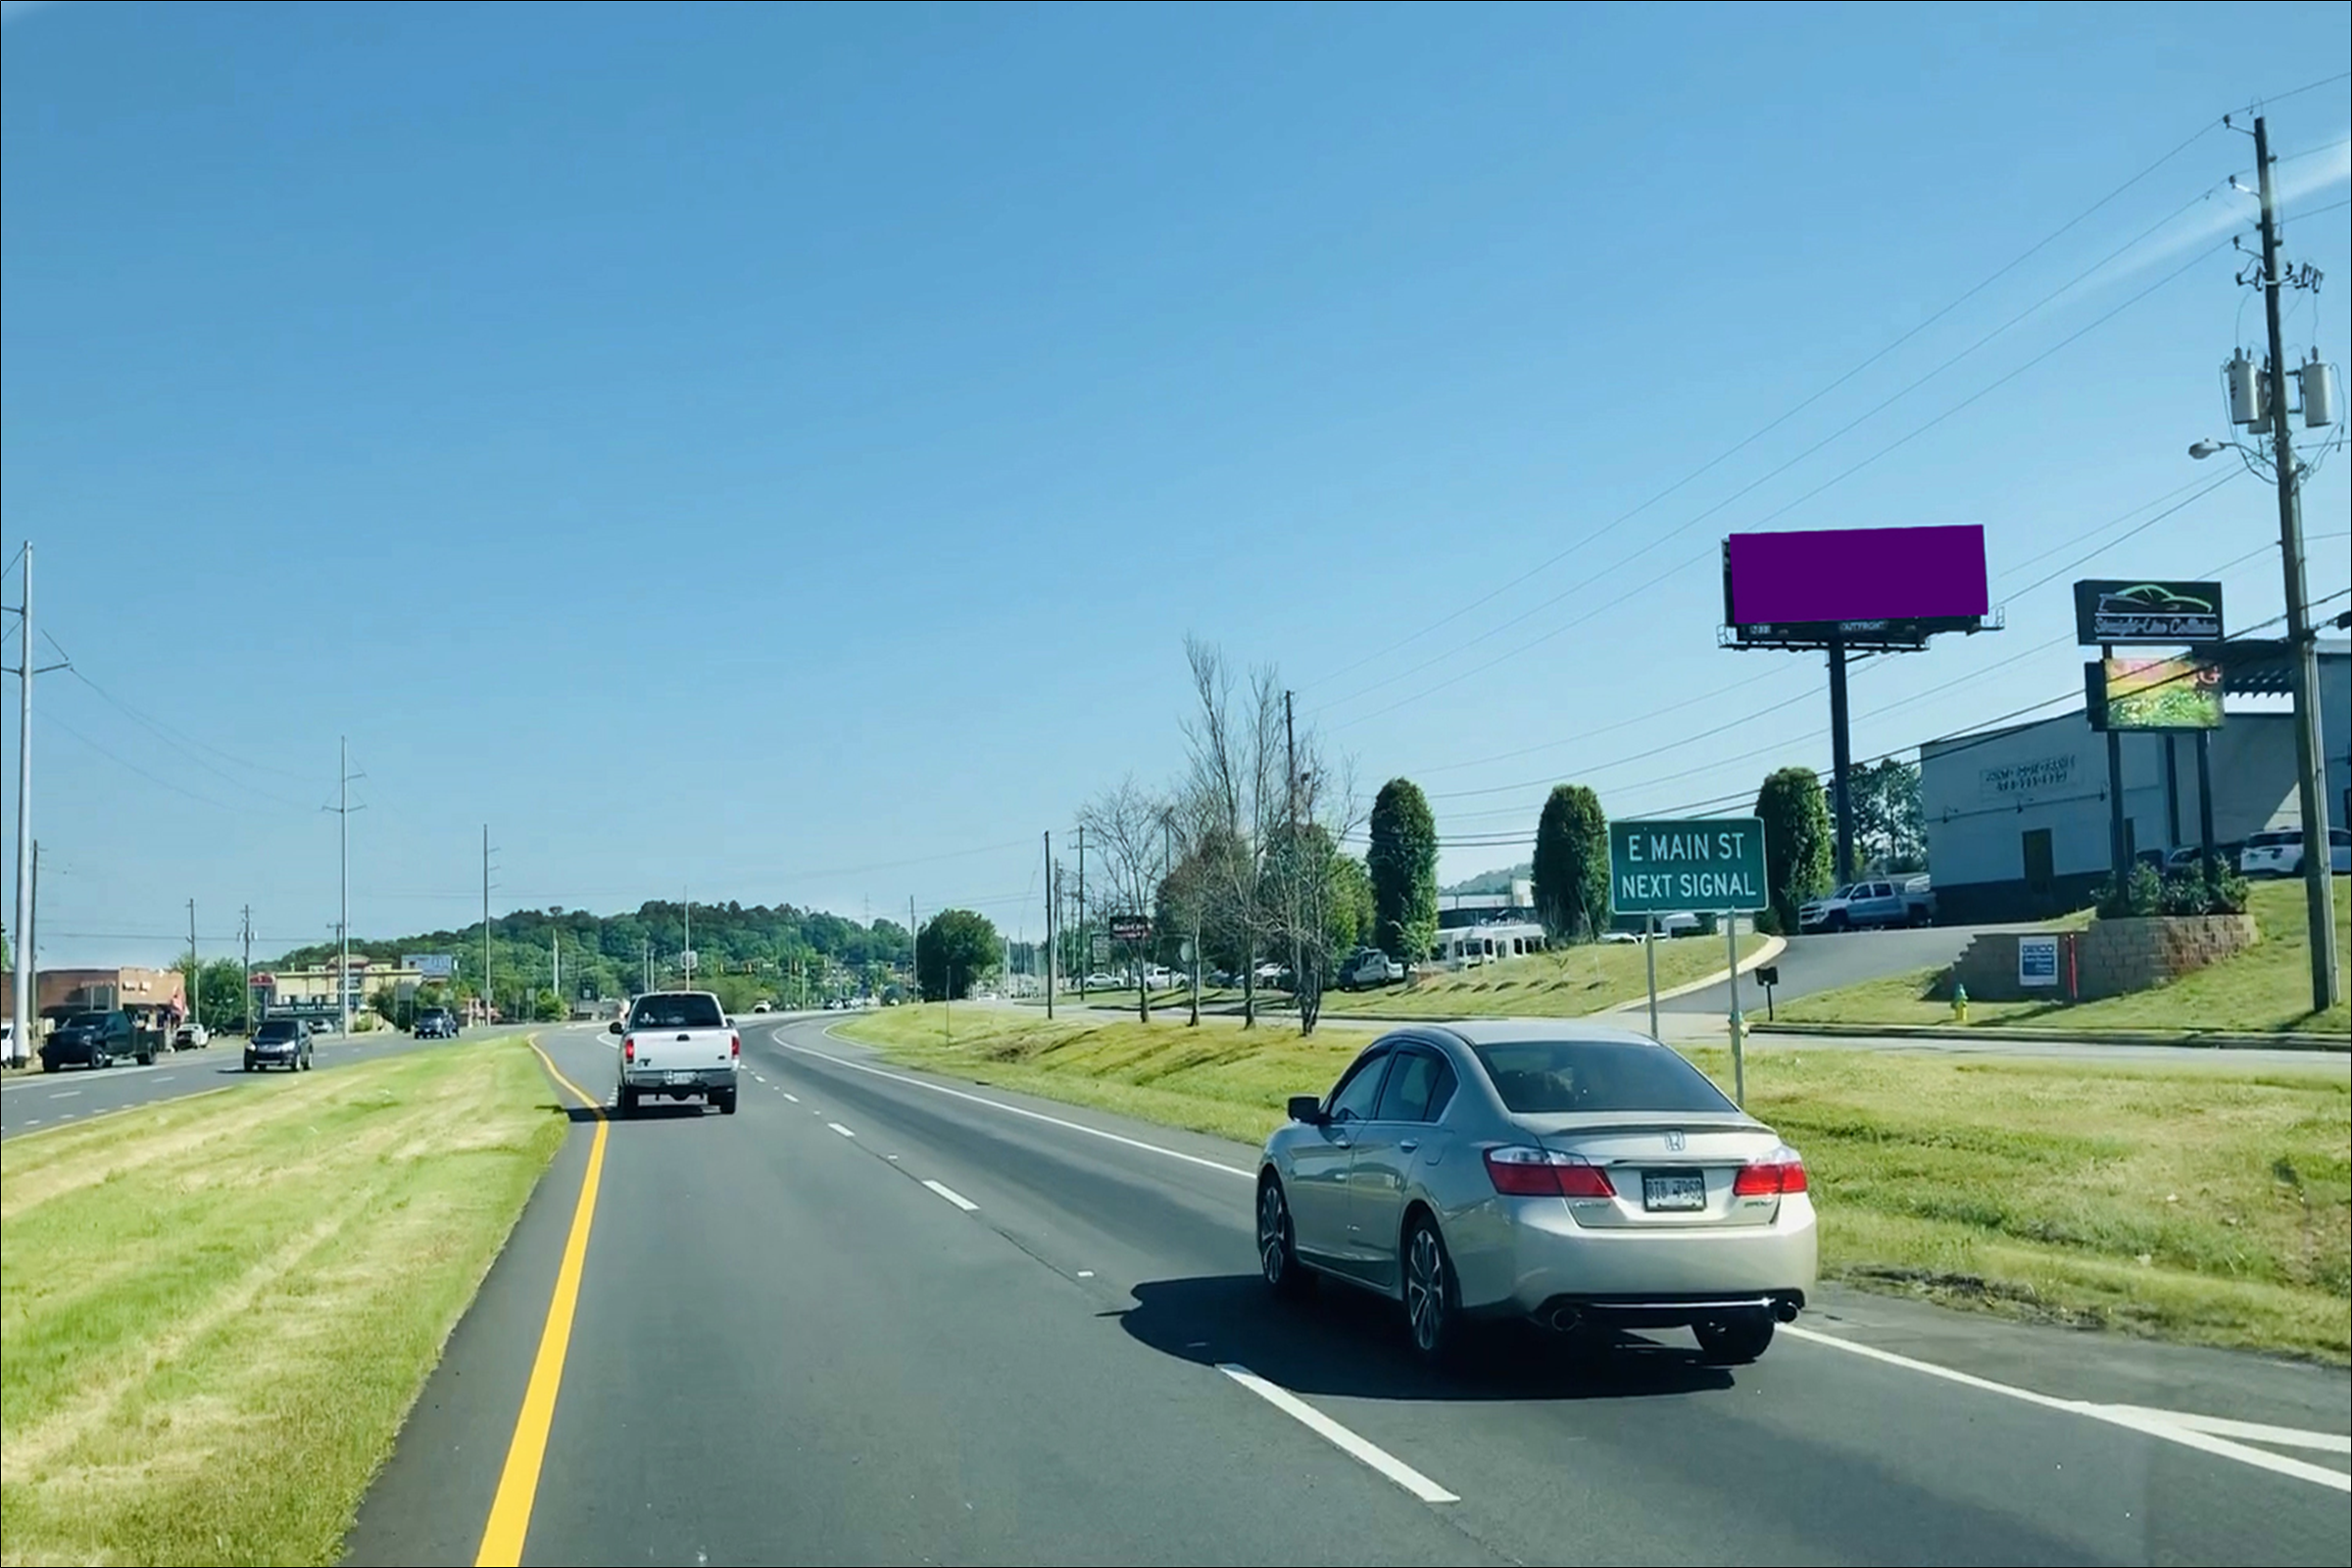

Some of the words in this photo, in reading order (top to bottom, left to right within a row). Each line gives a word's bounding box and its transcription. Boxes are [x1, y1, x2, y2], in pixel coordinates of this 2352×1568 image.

[1628, 835, 1643, 861] E
[1650, 833, 1710, 861] MAIN
[1718, 832, 1744, 859] ST
[1622, 874, 1673, 899] NEXT
[1680, 872, 1757, 898] SIGNAL
